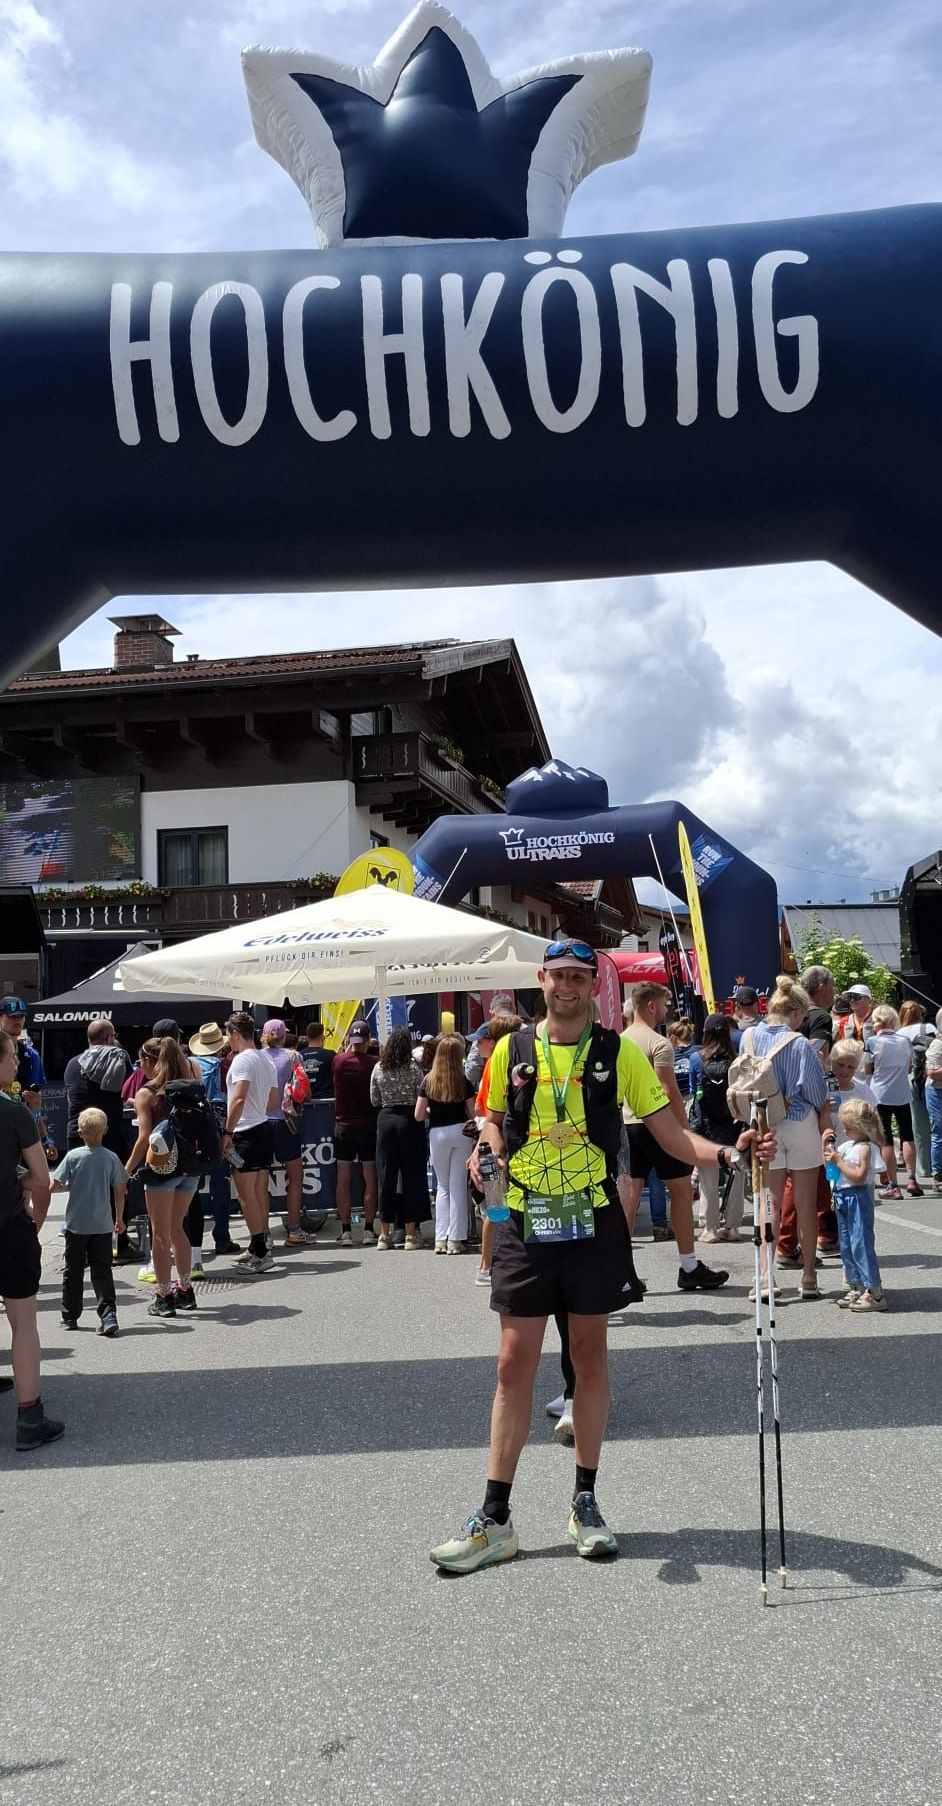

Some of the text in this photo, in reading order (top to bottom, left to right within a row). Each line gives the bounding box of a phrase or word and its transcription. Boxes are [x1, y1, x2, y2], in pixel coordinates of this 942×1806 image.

[109, 250, 819, 446] HOCHKÖNIG
[526, 831, 615, 848] HOCHKÖNIG
[505, 846, 582, 862] ULTRAKS
[243, 928, 388, 947] Edelweiss
[301, 951, 316, 960] DIR
[320, 949, 344, 959] EINS!
[33, 1010, 113, 1023] SALOMON
[531, 1217, 562, 1230] 2301
